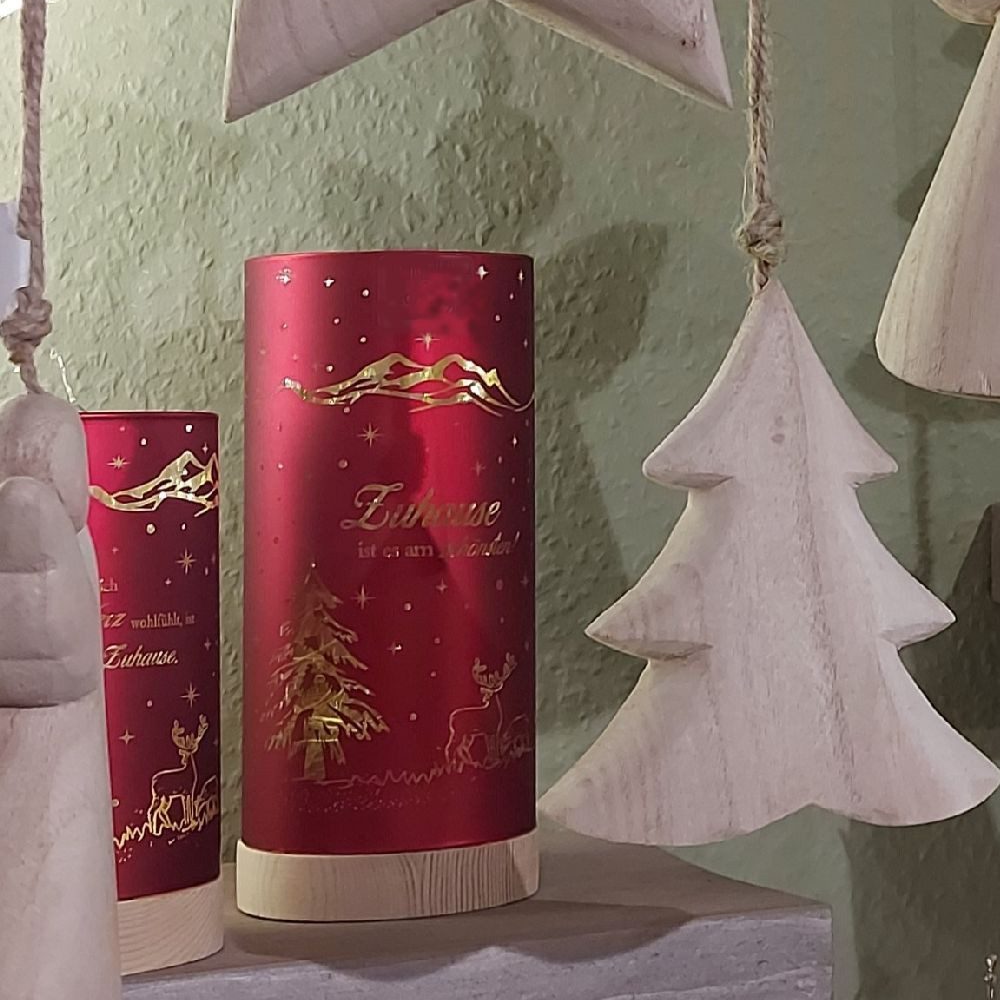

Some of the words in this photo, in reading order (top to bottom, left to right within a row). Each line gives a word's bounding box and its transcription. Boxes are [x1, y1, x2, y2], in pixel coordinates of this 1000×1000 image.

[341, 483, 502, 529] Zuhause
[358, 541, 377, 559] ist
[404, 543, 434, 559] am
[100, 578, 118, 592] ich
[104, 643, 178, 669] Zuhause.
